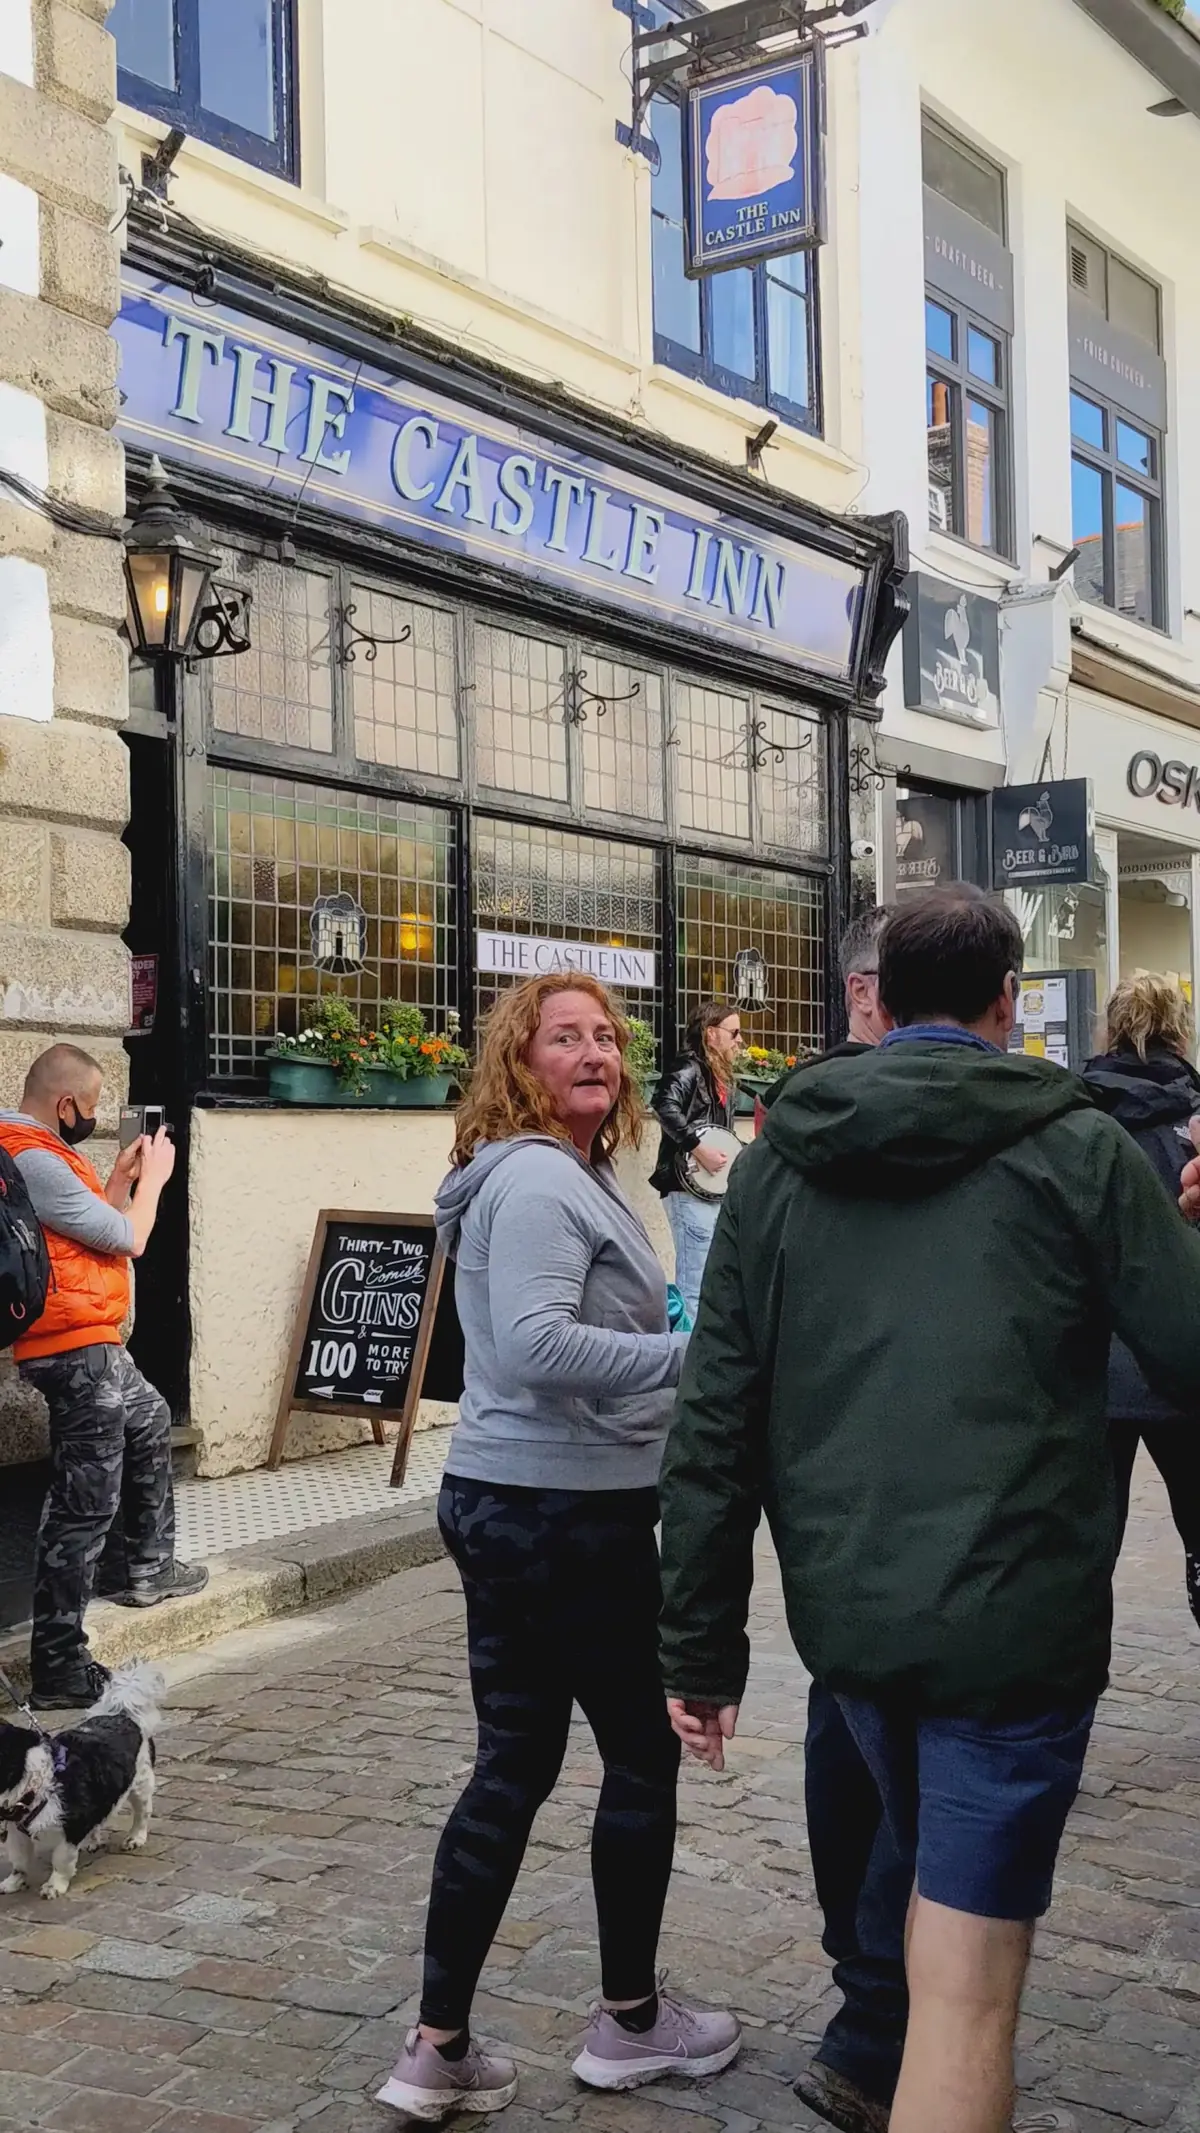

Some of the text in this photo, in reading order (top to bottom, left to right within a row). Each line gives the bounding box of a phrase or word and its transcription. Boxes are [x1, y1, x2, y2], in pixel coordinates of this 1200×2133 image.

[736, 201, 769, 222] THE
[705, 207, 802, 246] CASTLE INN
[934, 236, 967, 270] CRAFT
[163, 315, 788, 630] THE CASTLE INN
[1002, 848, 1036, 871] BEER
[1038, 849, 1046, 863] &
[487, 938, 529, 970] THE
[612, 953, 647, 982] INN
[338, 1236, 424, 1256] THIRTY-TWO
[366, 1260, 425, 1285] Cornish
[320, 1257, 422, 1329] GINS
[357, 1325, 368, 1339] &
[305, 1339, 358, 1379] 100
[368, 1343, 412, 1360] MORE
[365, 1358, 409, 1375] TO TRY
